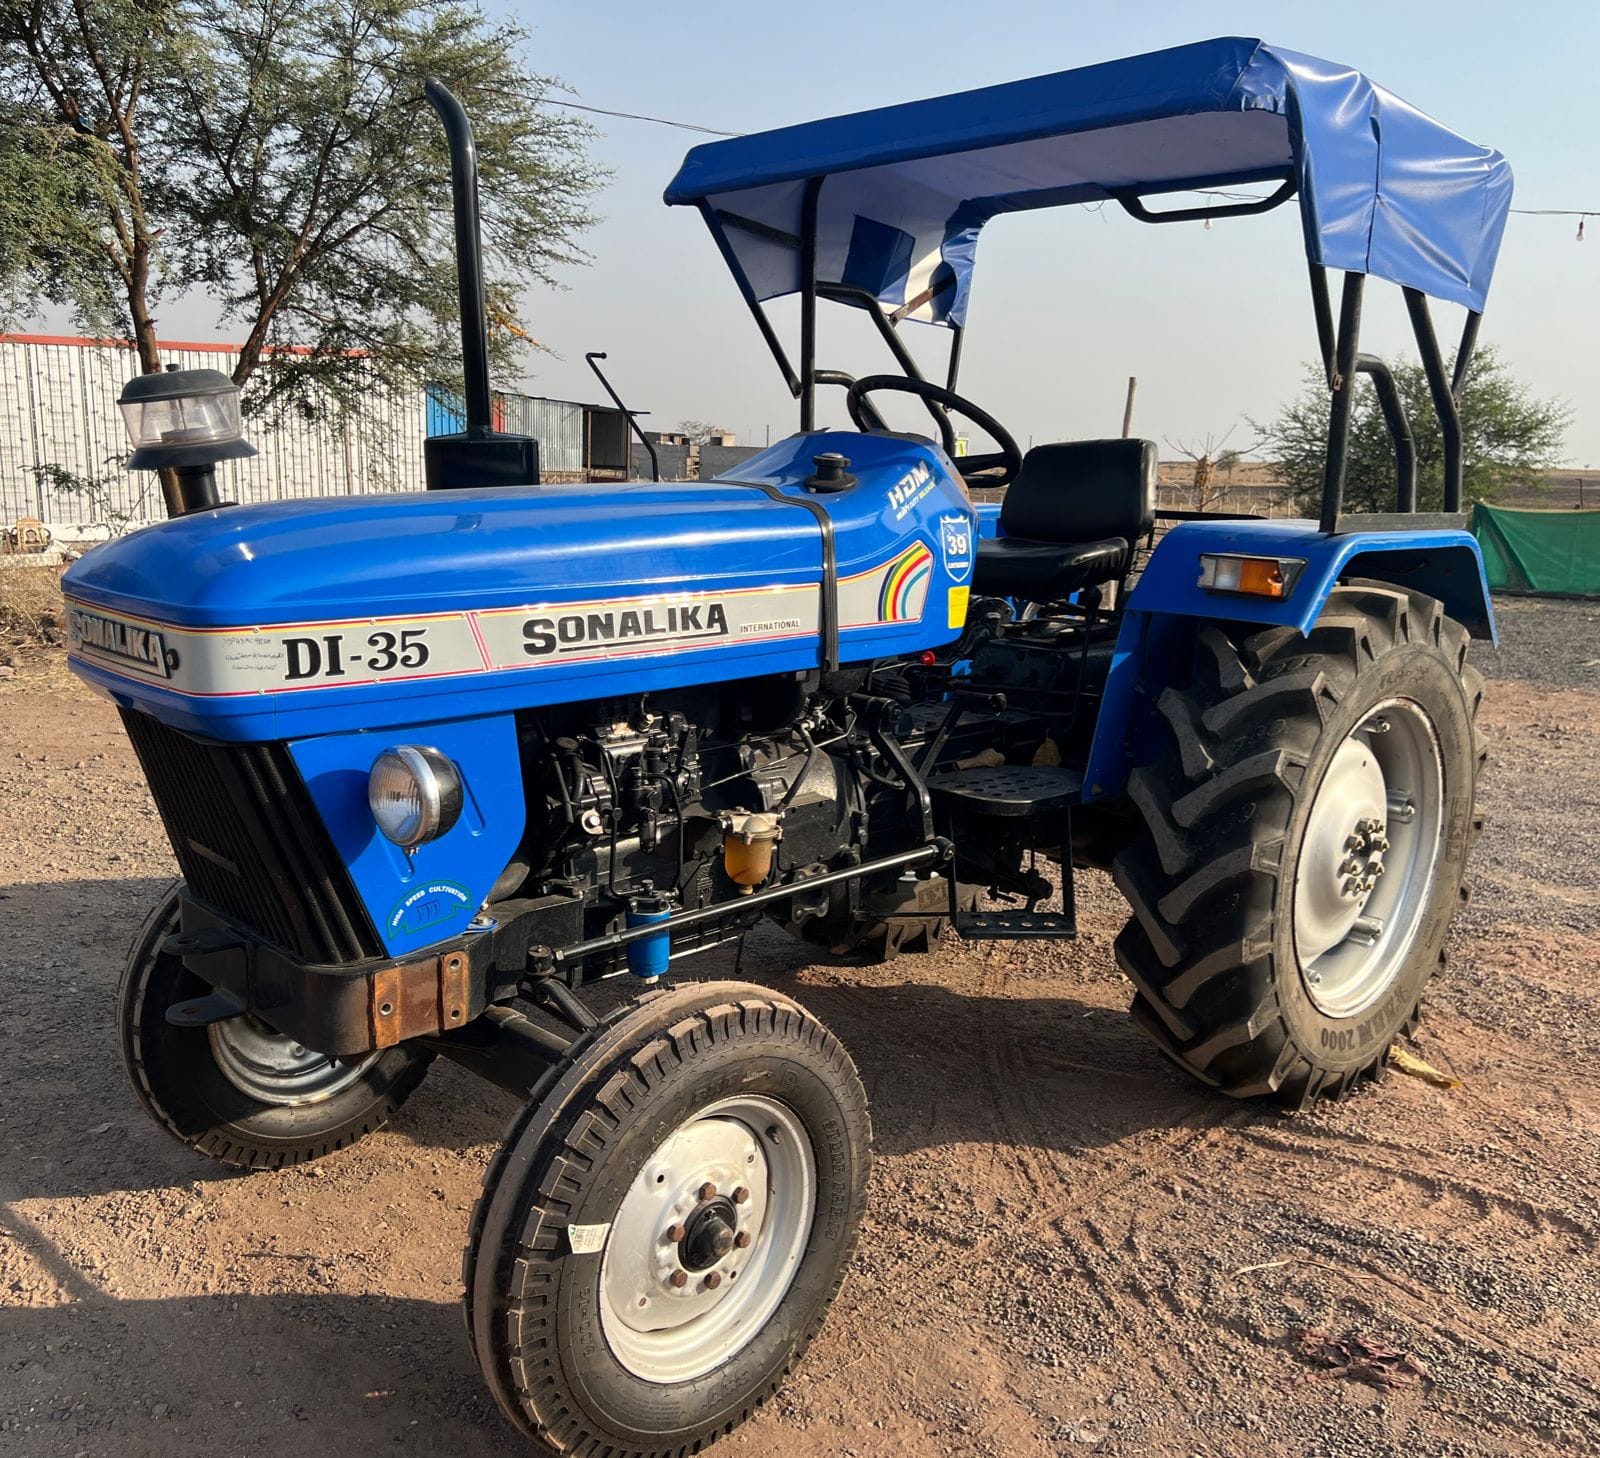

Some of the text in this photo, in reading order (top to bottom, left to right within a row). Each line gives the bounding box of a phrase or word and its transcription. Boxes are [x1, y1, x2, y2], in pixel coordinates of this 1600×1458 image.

[887, 460, 931, 511] HDM
[947, 535, 967, 556] 39
[69, 609, 171, 679] SONALIKA
[521, 602, 729, 656] SONALIKA
[739, 618, 801, 634] INTERNATIONAL
[281, 627, 430, 681] DI-35
[391, 908, 405, 927] HIGH
[405, 889, 426, 907] SPEED
[1320, 1026, 1356, 1051] 2000
